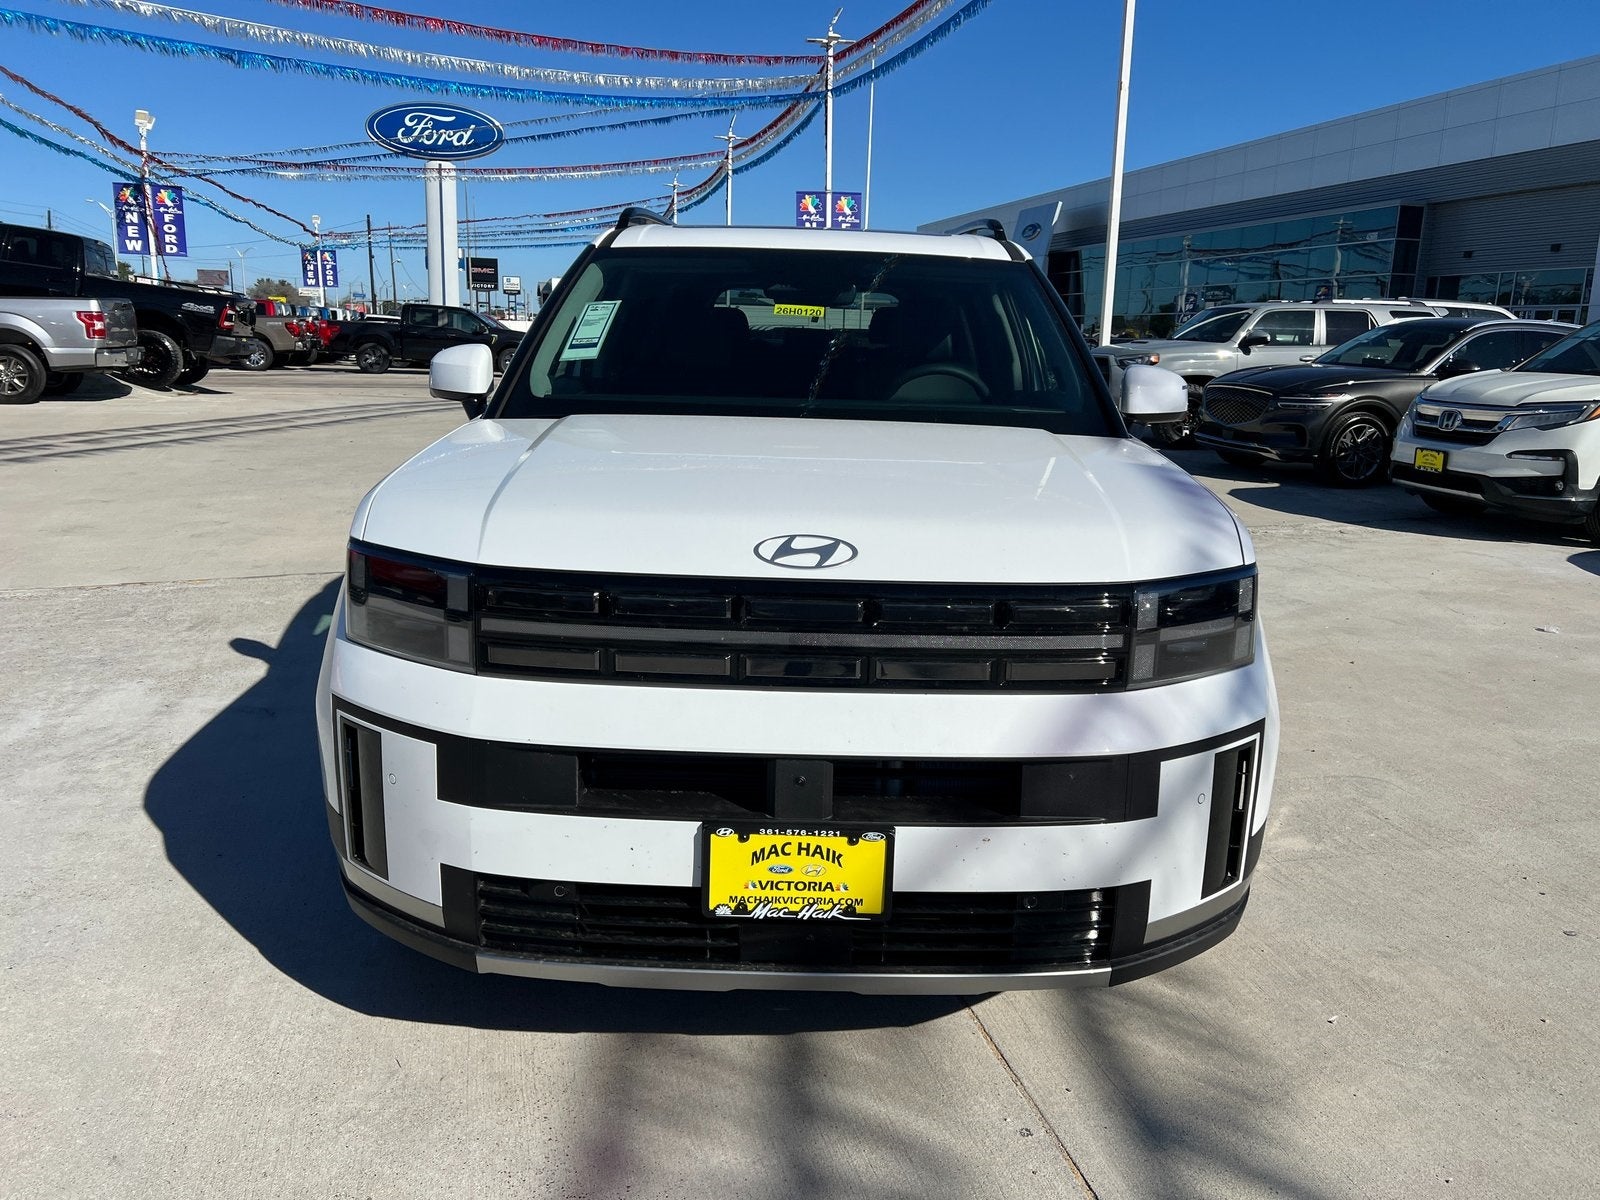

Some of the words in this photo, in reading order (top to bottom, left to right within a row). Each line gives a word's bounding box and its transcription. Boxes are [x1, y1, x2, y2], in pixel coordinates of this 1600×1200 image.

[397, 112, 476, 146] Ford
[124, 211, 142, 251] NEW
[163, 213, 178, 254] FORD
[306, 264, 316, 286] NEW
[325, 264, 334, 286] FORD
[776, 307, 822, 316] 26H0120
[759, 828, 841, 837] 361-576-1221
[751, 841, 792, 866] MAC
[796, 841, 844, 868] HAIK
[757, 880, 835, 892] VICTORIA
[750, 902, 794, 920] Mac
[796, 903, 846, 920] Haik
